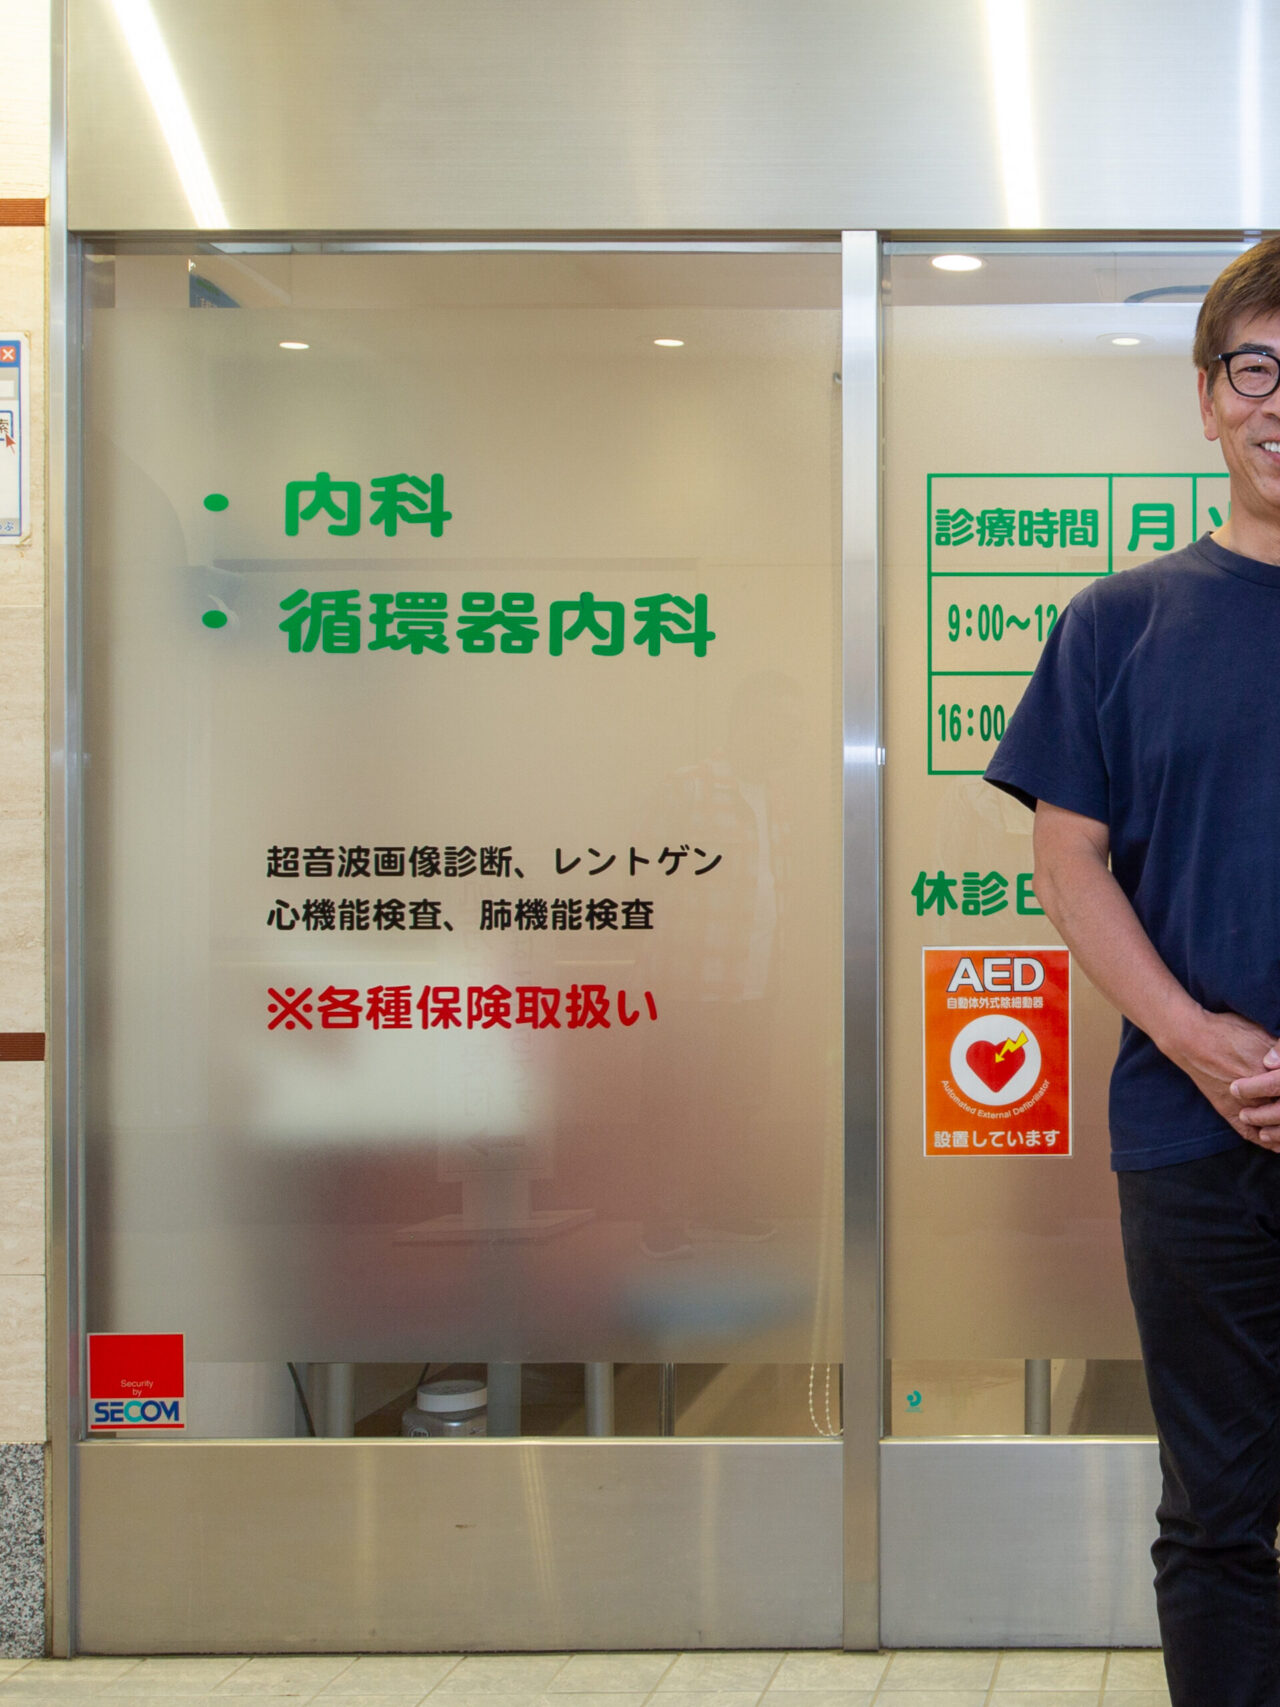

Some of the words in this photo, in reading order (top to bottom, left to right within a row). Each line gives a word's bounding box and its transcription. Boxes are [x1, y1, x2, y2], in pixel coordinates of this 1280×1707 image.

[284, 471, 453, 539] 内科
[934, 507, 1099, 549] 診療時間
[1126, 502, 1176, 552] 月
[277, 587, 717, 658] 循環器内科
[937, 703, 1013, 743] 16:00
[946, 957, 1045, 992] AED
[941, 1080, 976, 1114] Automated
[977, 1109, 1012, 1119] External
[1012, 1079, 1050, 1115] Defibrillator
[933, 1129, 1061, 1148] 設置しています
[120, 1379, 154, 1390] Security
[132, 1388, 143, 1398] by
[94, 1400, 180, 1423] SECOM
